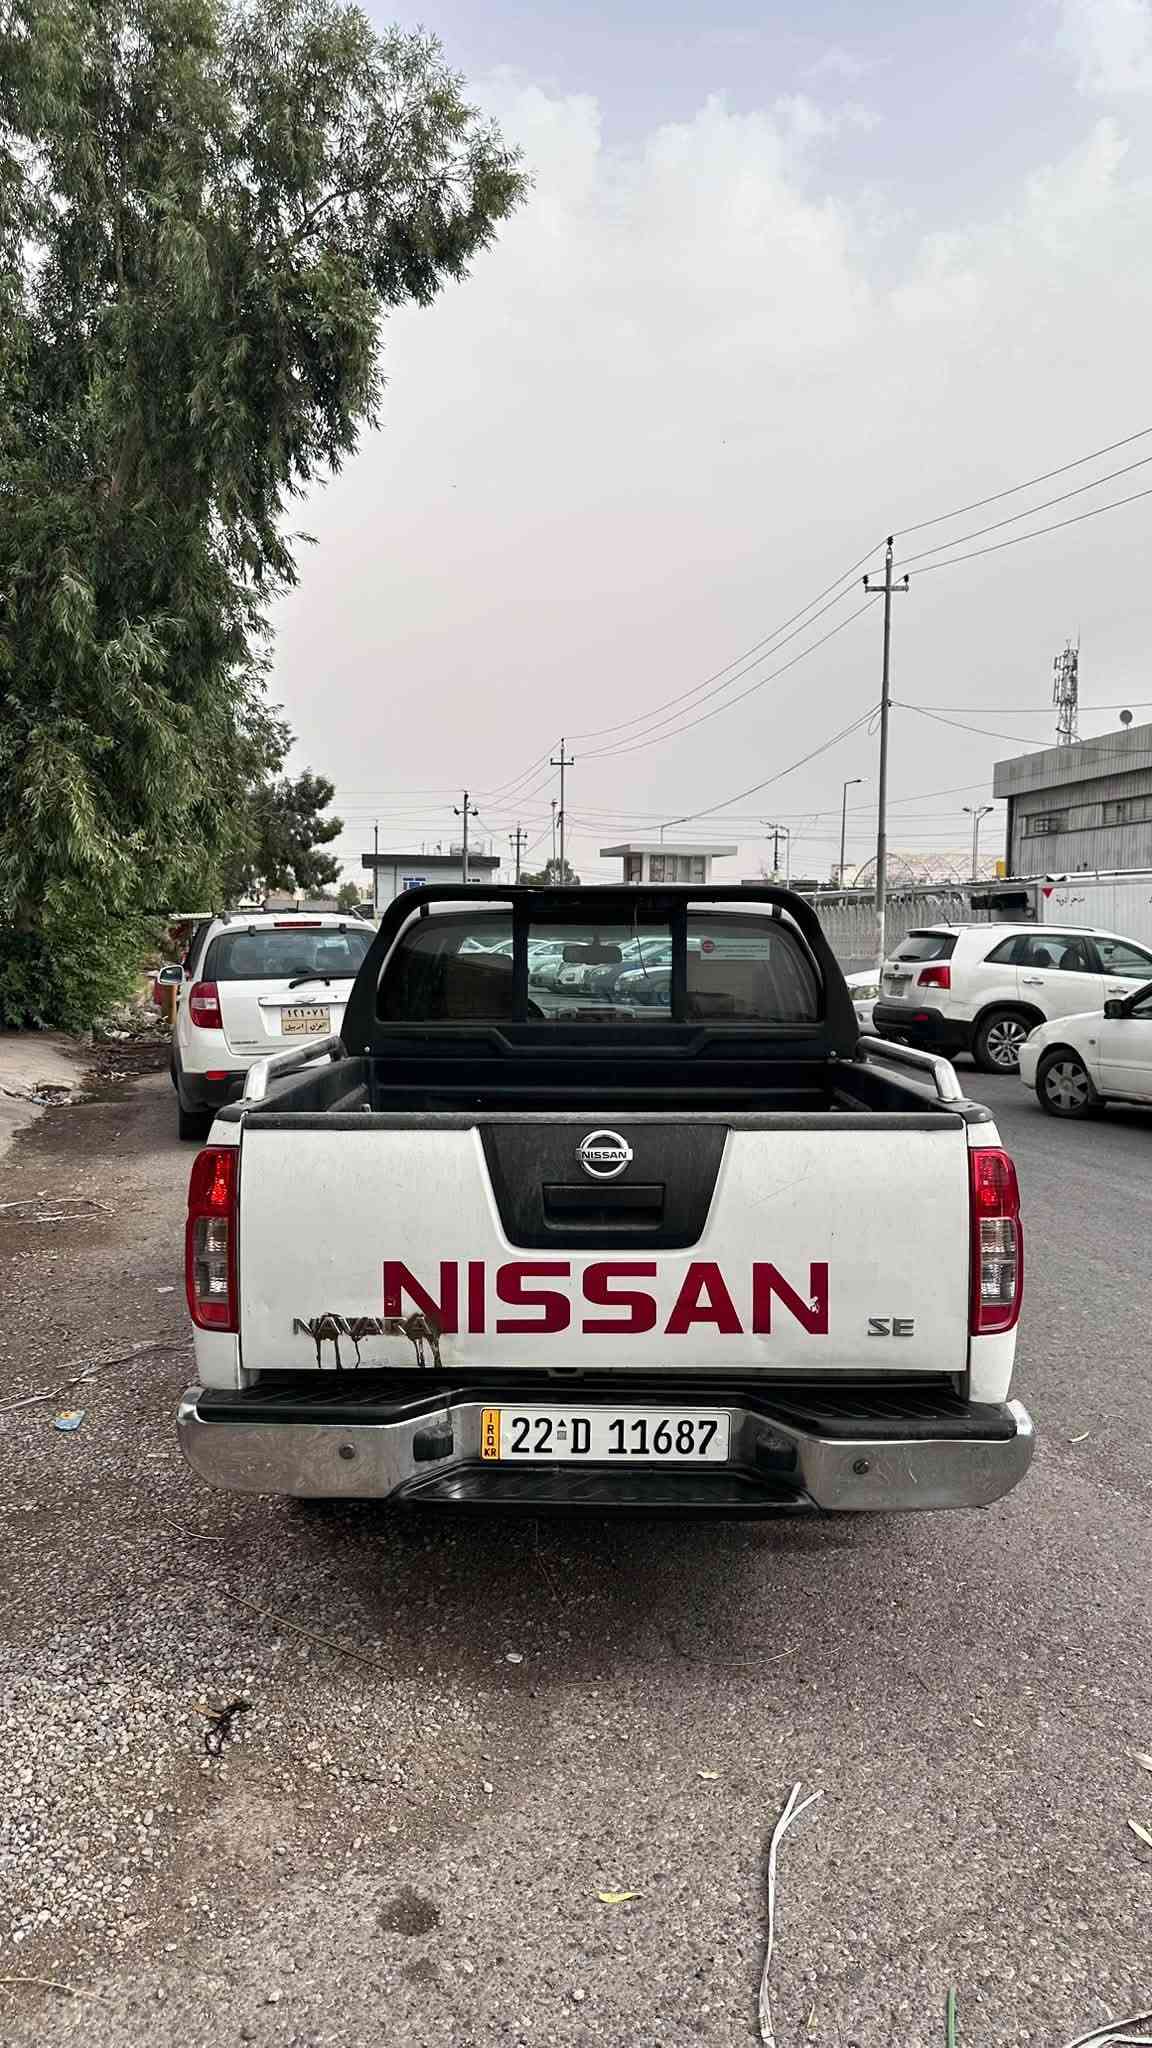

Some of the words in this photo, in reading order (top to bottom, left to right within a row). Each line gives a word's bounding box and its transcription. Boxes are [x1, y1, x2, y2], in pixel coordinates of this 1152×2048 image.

[581, 1151, 627, 1159] NISSAN
[383, 1261, 829, 1335] NISSAN
[867, 1317, 915, 1337] SE
[511, 1417, 553, 1454] 22
[571, 1418, 591, 1454] D
[608, 1419, 718, 1455] 11687
[484, 1447, 497, 1457] KR
